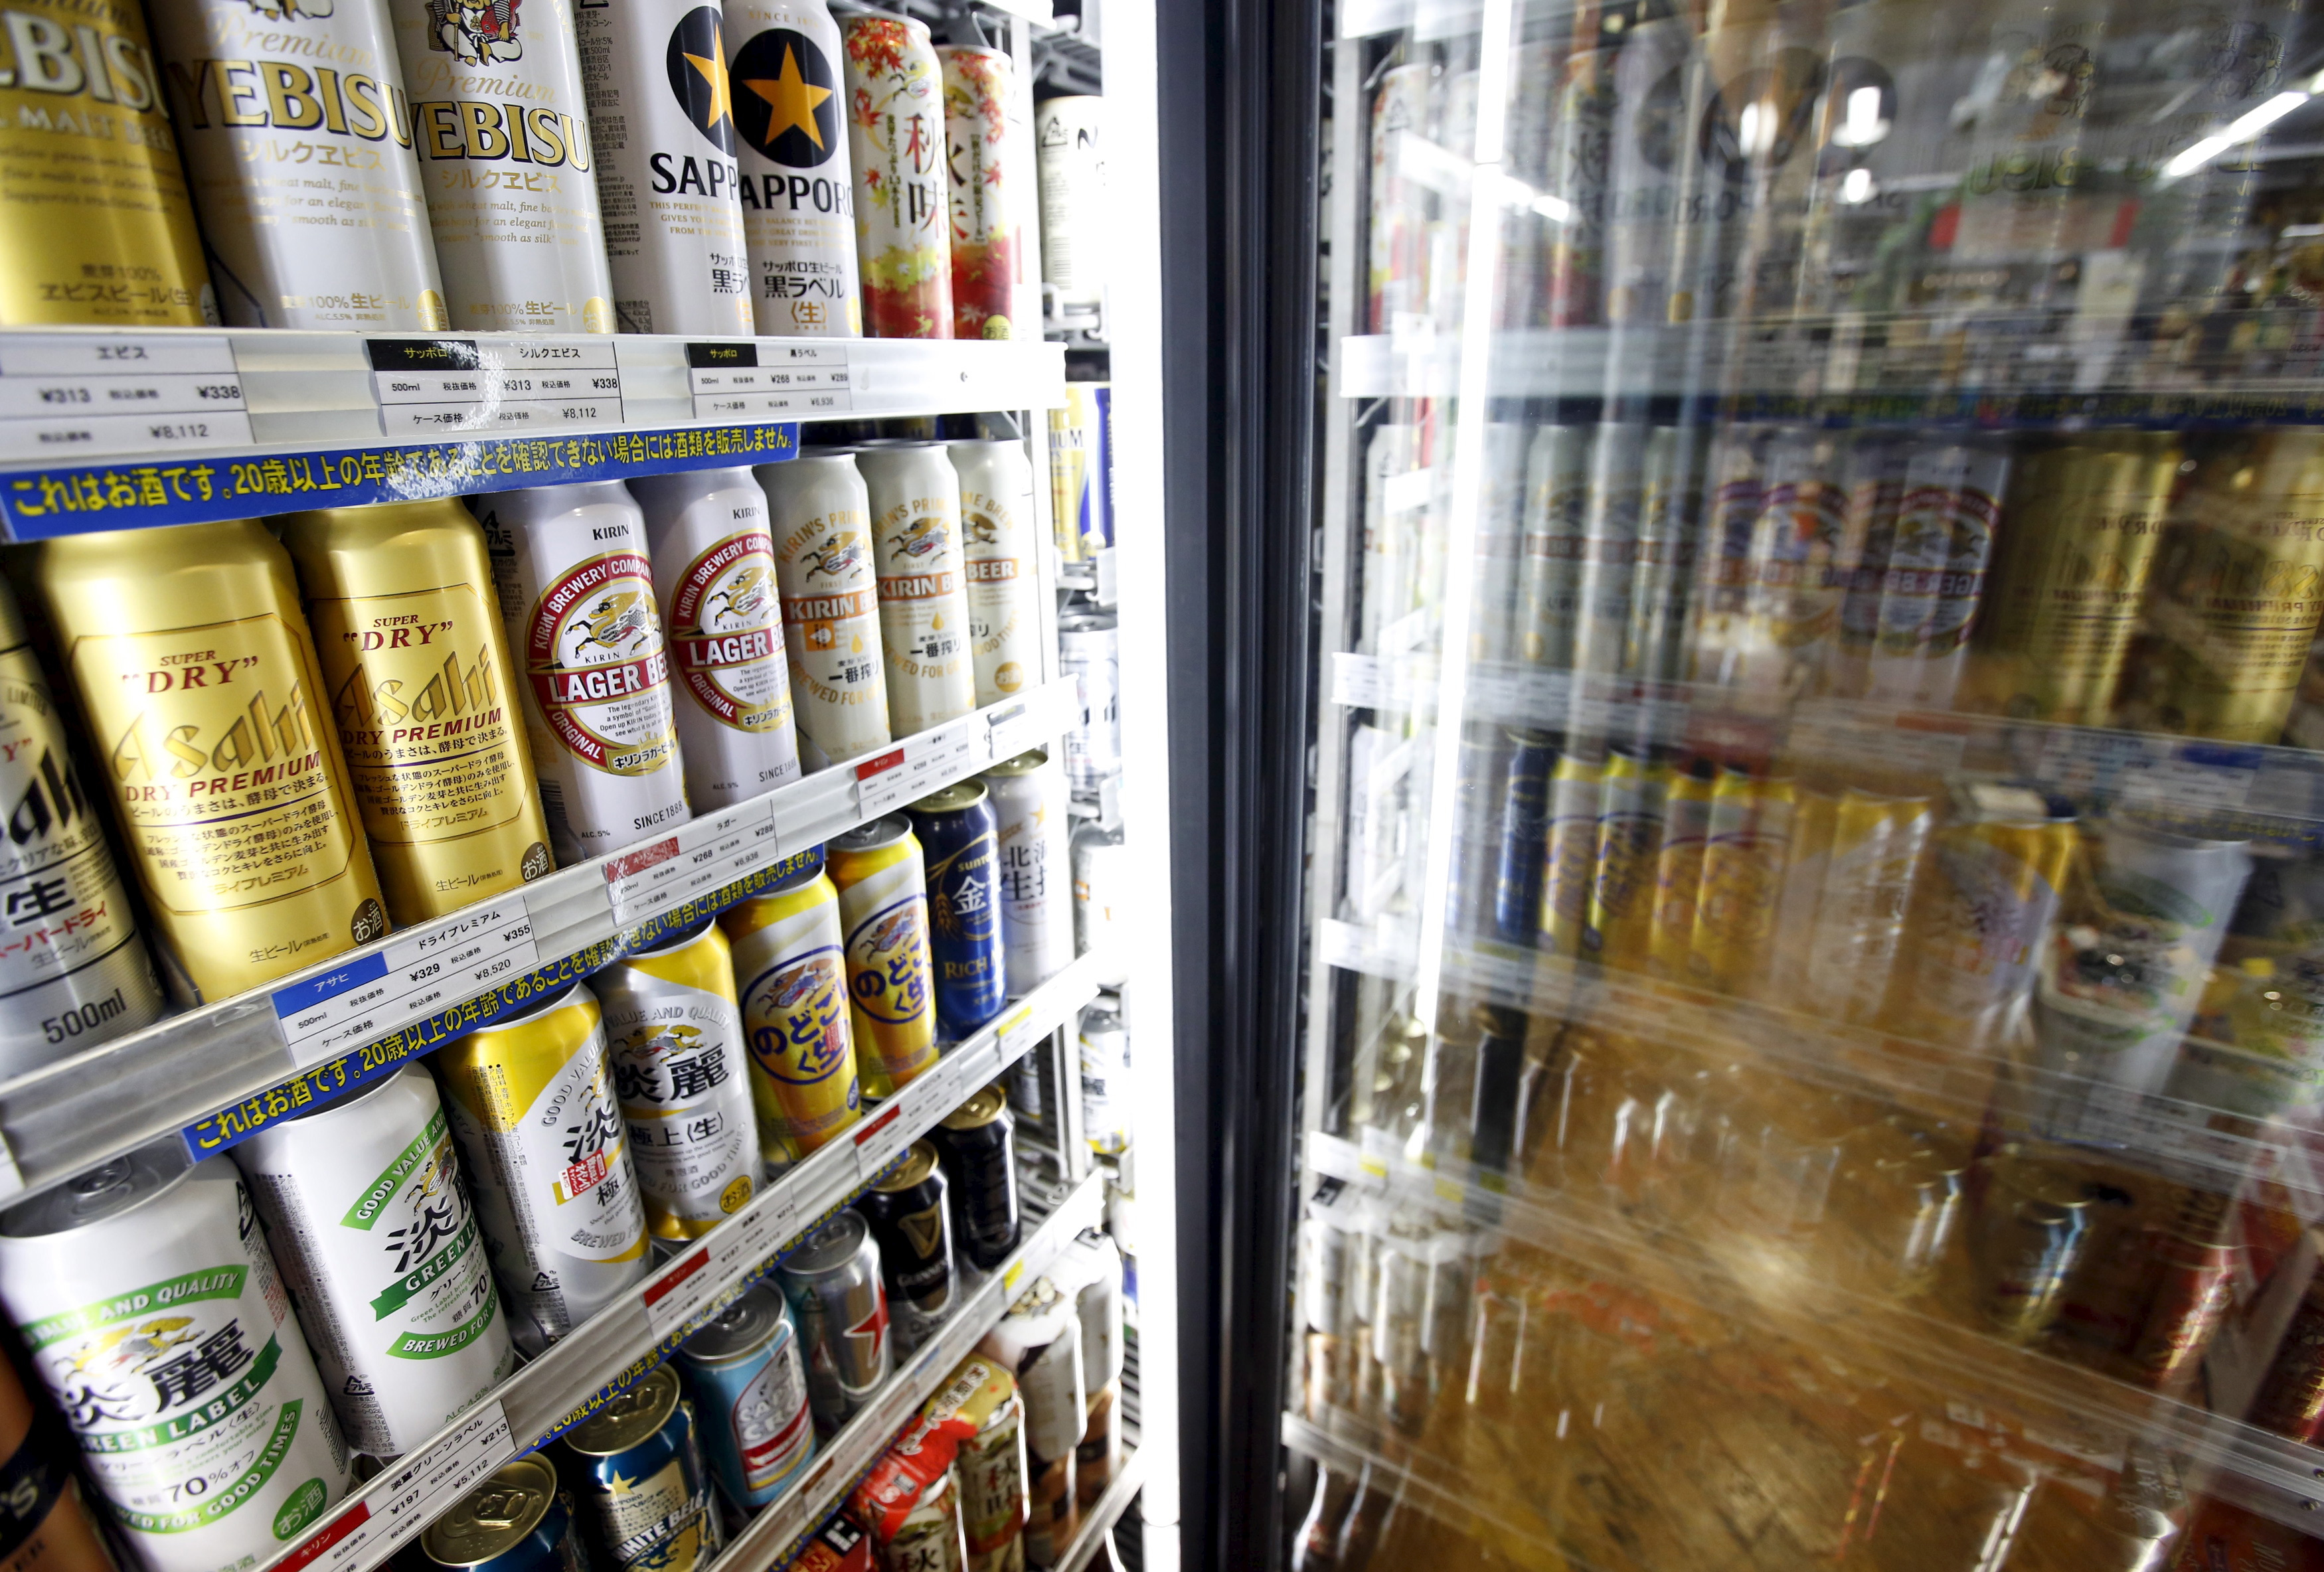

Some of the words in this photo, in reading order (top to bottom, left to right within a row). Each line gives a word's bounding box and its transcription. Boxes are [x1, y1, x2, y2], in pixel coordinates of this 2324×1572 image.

[749, 11, 790, 23] SINCE
[205, 9, 374, 67] Premium
[415, 56, 558, 103] Premium
[166, 59, 412, 150] YEBISU
[650, 152, 738, 201] SAPP
[489, 200, 517, 212] malt,
[519, 201, 539, 214] fine
[650, 201, 671, 210] THIS
[661, 214, 688, 223] GIVES
[509, 218, 546, 229] elegant
[520, 235, 532, 244] as
[763, 260, 843, 275] サッポロ生ビール
[764, 274, 845, 299] 黒ラベル
[404, 347, 448, 359] サッポロ
[519, 347, 582, 359] シルクエビス
[709, 349, 738, 359] サッポロ
[789, 349, 817, 358] 黒ラベル
[196, 385, 242, 400] ¥338
[392, 382, 420, 392] 500ml
[442, 382, 477, 392] 税抜価格
[503, 379, 532, 392] ¥313
[541, 380, 572, 389] 税込価格
[592, 377, 618, 390] ¥338
[770, 374, 790, 384] ¥268
[412, 413, 463, 425] ケース価格
[499, 410, 530, 421] 税込価格
[562, 407, 597, 420] ¥8,112
[712, 401, 746, 411] ケース価格
[733, 505, 761, 520] KIRIN
[592, 524, 630, 541] KIRIN
[679, 583, 701, 619] KIRIN
[693, 540, 745, 586] BREWERY
[966, 560, 1015, 581] BEER
[878, 576, 937, 597] KIRIN
[373, 614, 419, 628] SUPER
[535, 611, 557, 651] KIRIN
[548, 563, 608, 614] BREWERY
[789, 595, 856, 621] KIRIN
[159, 649, 216, 667] SUPER
[585, 651, 620, 665] KIRIN
[689, 631, 770, 667] LAGER
[334, 641, 497, 728] Asahi
[548, 665, 643, 703] LAGER
[691, 673, 733, 718] ORIGINAL
[112, 678, 314, 783] Asahi
[343, 730, 384, 746] DRY
[392, 706, 502, 744] PREMIUM
[551, 710, 600, 759] ORIGINAL
[600, 724, 618, 732] Open
[614, 738, 676, 769] キリンラガービール
[125, 782, 183, 802] DRY
[189, 750, 321, 798] PREMIUM
[758, 765, 784, 783] SINCE
[399, 807, 489, 830] ドライプレミアム
[633, 810, 665, 830] SINCE
[666, 800, 683, 818] 1888
[692, 850, 714, 864] ¥268
[754, 824, 774, 837] ¥289
[523, 849, 550, 881] お酒
[6, 877, 76, 926] 生
[952, 874, 988, 916] 金
[353, 906, 383, 942] お酒
[313, 972, 350, 993] アサヒ
[418, 910, 501, 950] ドライプレミアム
[297, 1012, 328, 1030] 500ml
[349, 987, 385, 1008] 税抜価格
[409, 963, 441, 982] ¥329
[450, 946, 482, 965] 税込価格
[502, 923, 531, 943] ¥355
[944, 956, 989, 980] RICH
[41, 987, 127, 1044] 500ml
[321, 1020, 374, 1048] ケース価格
[408, 990, 442, 1010] 税込価格
[474, 959, 512, 981] ¥8,520
[653, 1006, 683, 1020] AND
[688, 1006, 731, 1030] QUALITY
[542, 1083, 573, 1128] GOOD
[356, 1178, 396, 1221] GOOD
[392, 1134, 433, 1177] VALUE
[691, 1162, 726, 1191] GOOD
[570, 1228, 626, 1249] BREWED
[404, 1237, 466, 1293] GREEN
[100, 1293, 150, 1321] AND
[156, 1273, 240, 1304] QUALITY
[402, 1329, 469, 1355] BREWED
[469, 1309, 490, 1335] FOR
[167, 1378, 262, 1439] LABEL
[206, 1471, 264, 1514] GOOD
[260, 1409, 296, 1468] TIMES
[300, 1533, 333, 1560] キリン
[390, 1418, 484, 1492] 淡麗グリーンラベル
[332, 1532, 367, 1561] 税抜価格
[390, 1489, 420, 1516] ¥197
[429, 1460, 460, 1485] 税込価格
[480, 1423, 508, 1447] ¥213
[278, 1482, 321, 1533] お酒
[390, 1512, 422, 1539] 税込価格
